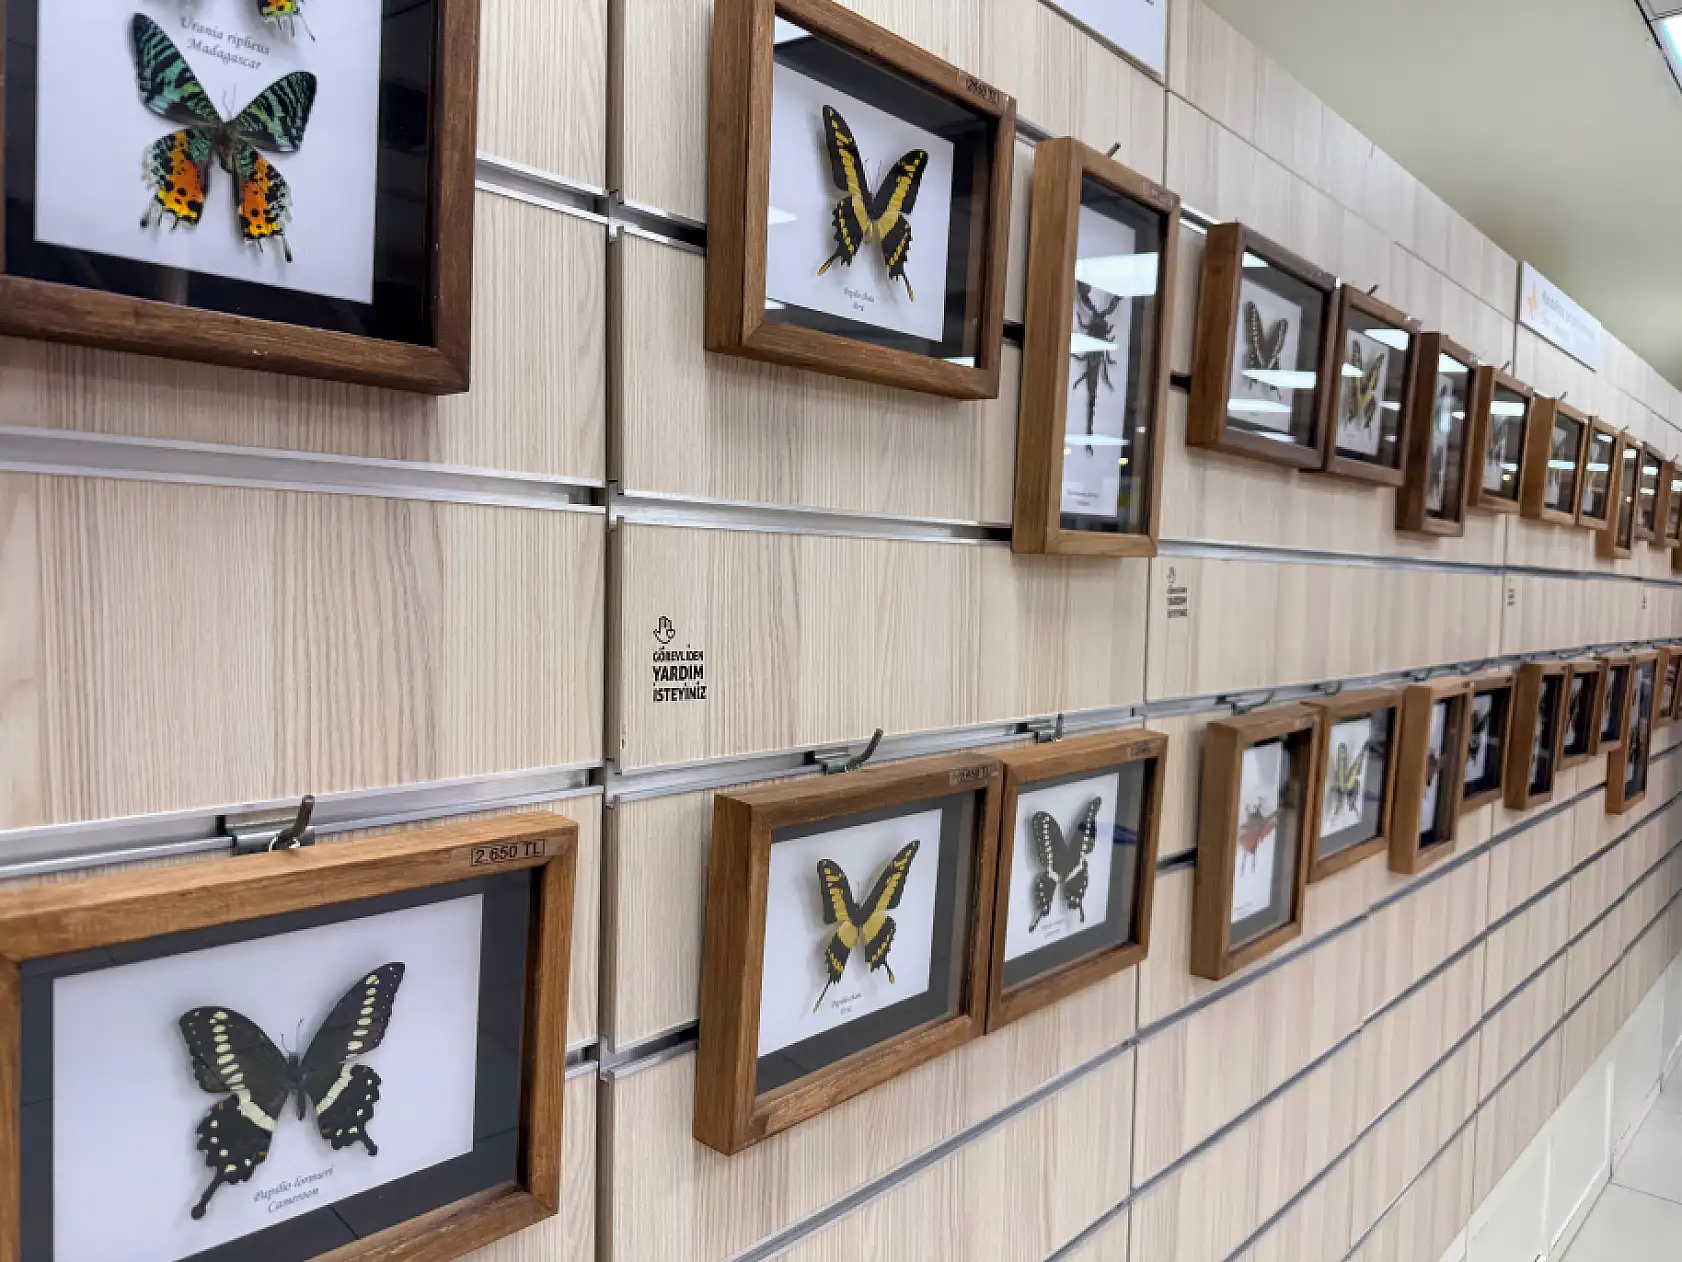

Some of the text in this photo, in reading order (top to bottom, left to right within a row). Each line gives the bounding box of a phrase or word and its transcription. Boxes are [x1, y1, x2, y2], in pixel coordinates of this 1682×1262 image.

[181, 16, 270, 56] Urania ripheus
[186, 38, 262, 70] Madagascar
[652, 643, 704, 662] GÖREVLİDEN
[652, 664, 704, 681] YARDIM
[652, 681, 708, 702] İSTEYİNİZ
[474, 840, 541, 864] 2.650 TL
[253, 1181, 292, 1202] Papilio
[268, 1187, 319, 1212] Cameroon
